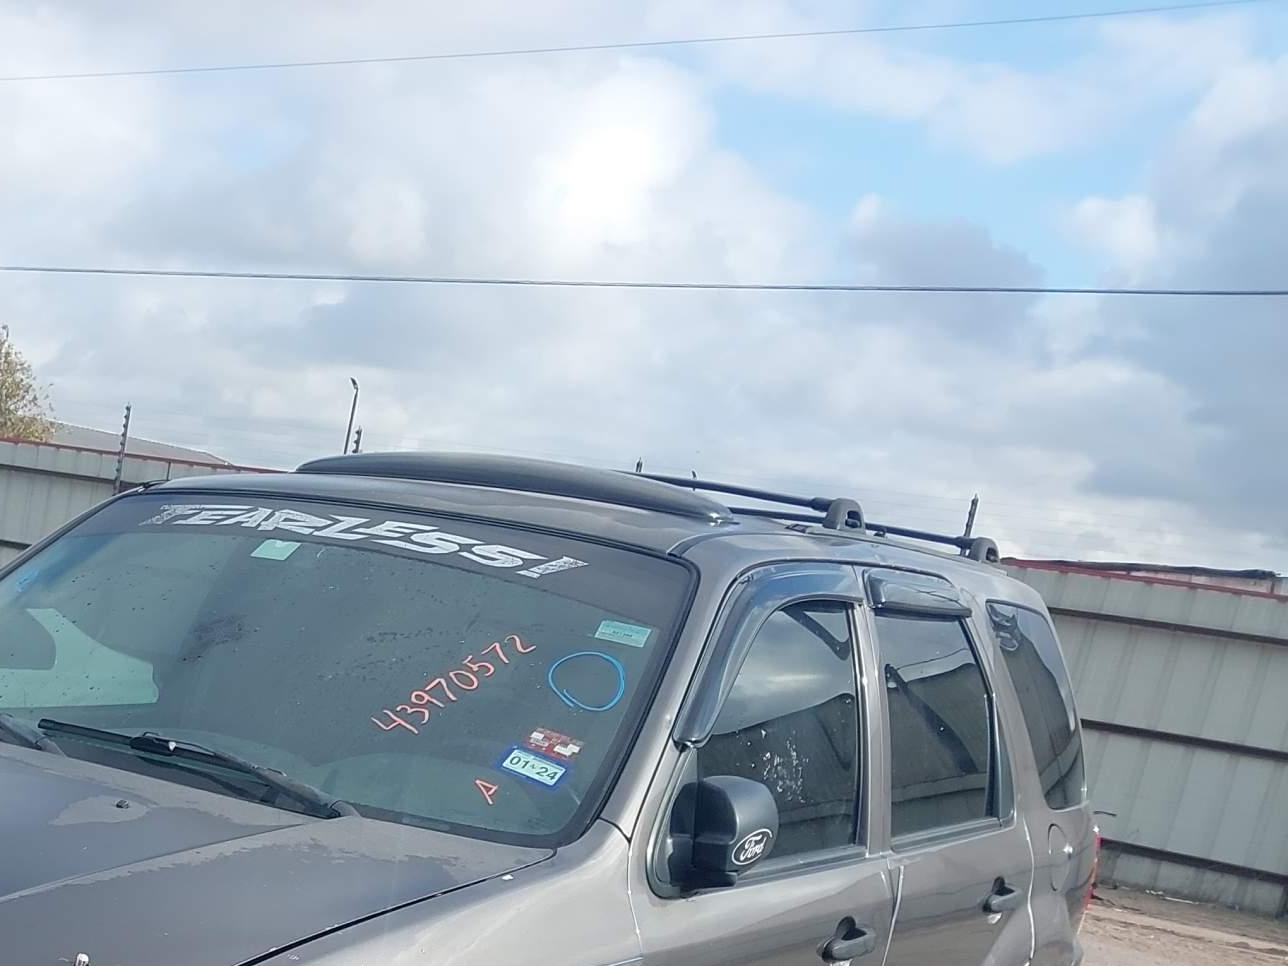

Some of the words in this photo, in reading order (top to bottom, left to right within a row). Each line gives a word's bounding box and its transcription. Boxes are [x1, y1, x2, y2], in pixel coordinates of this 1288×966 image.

[137, 503, 590, 579] FEARLESS!
[370, 634, 537, 735] 43970572
[475, 778, 499, 805] A
[739, 834, 768, 862] Ford
